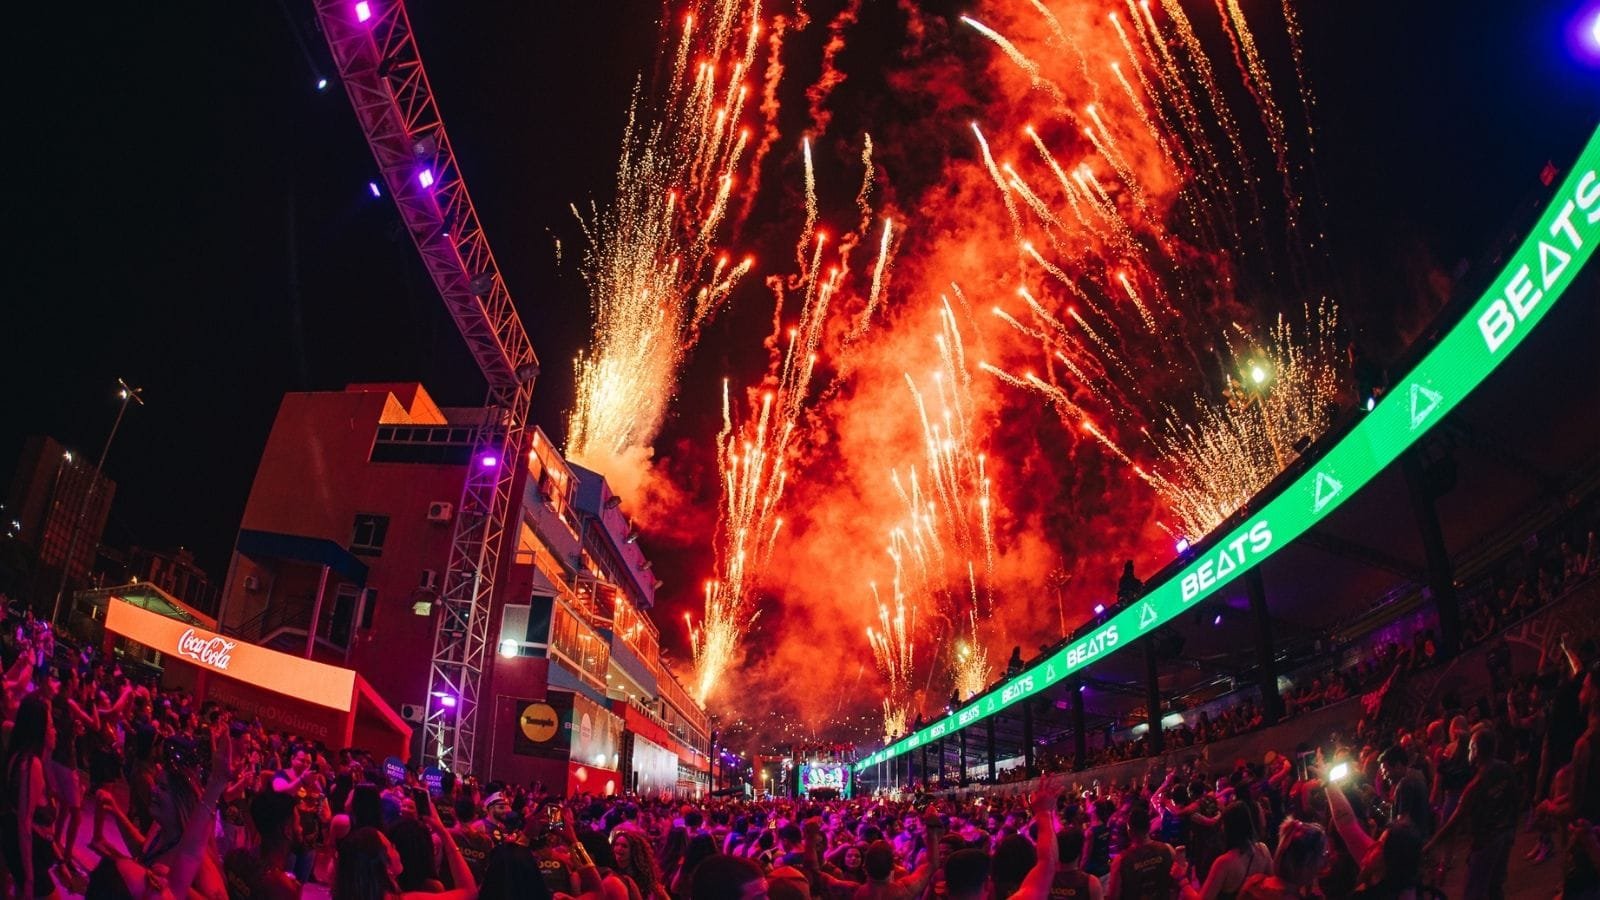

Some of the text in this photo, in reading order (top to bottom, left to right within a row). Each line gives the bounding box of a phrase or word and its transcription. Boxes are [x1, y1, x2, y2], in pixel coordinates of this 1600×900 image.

[1477, 170, 1600, 353] BEATS
[1180, 519, 1273, 602] BEATS
[177, 628, 238, 670] Coca-Cola
[1066, 625, 1119, 669] BEATS
[1001, 676, 1034, 704] BEATS
[958, 705, 981, 726] BEATS
